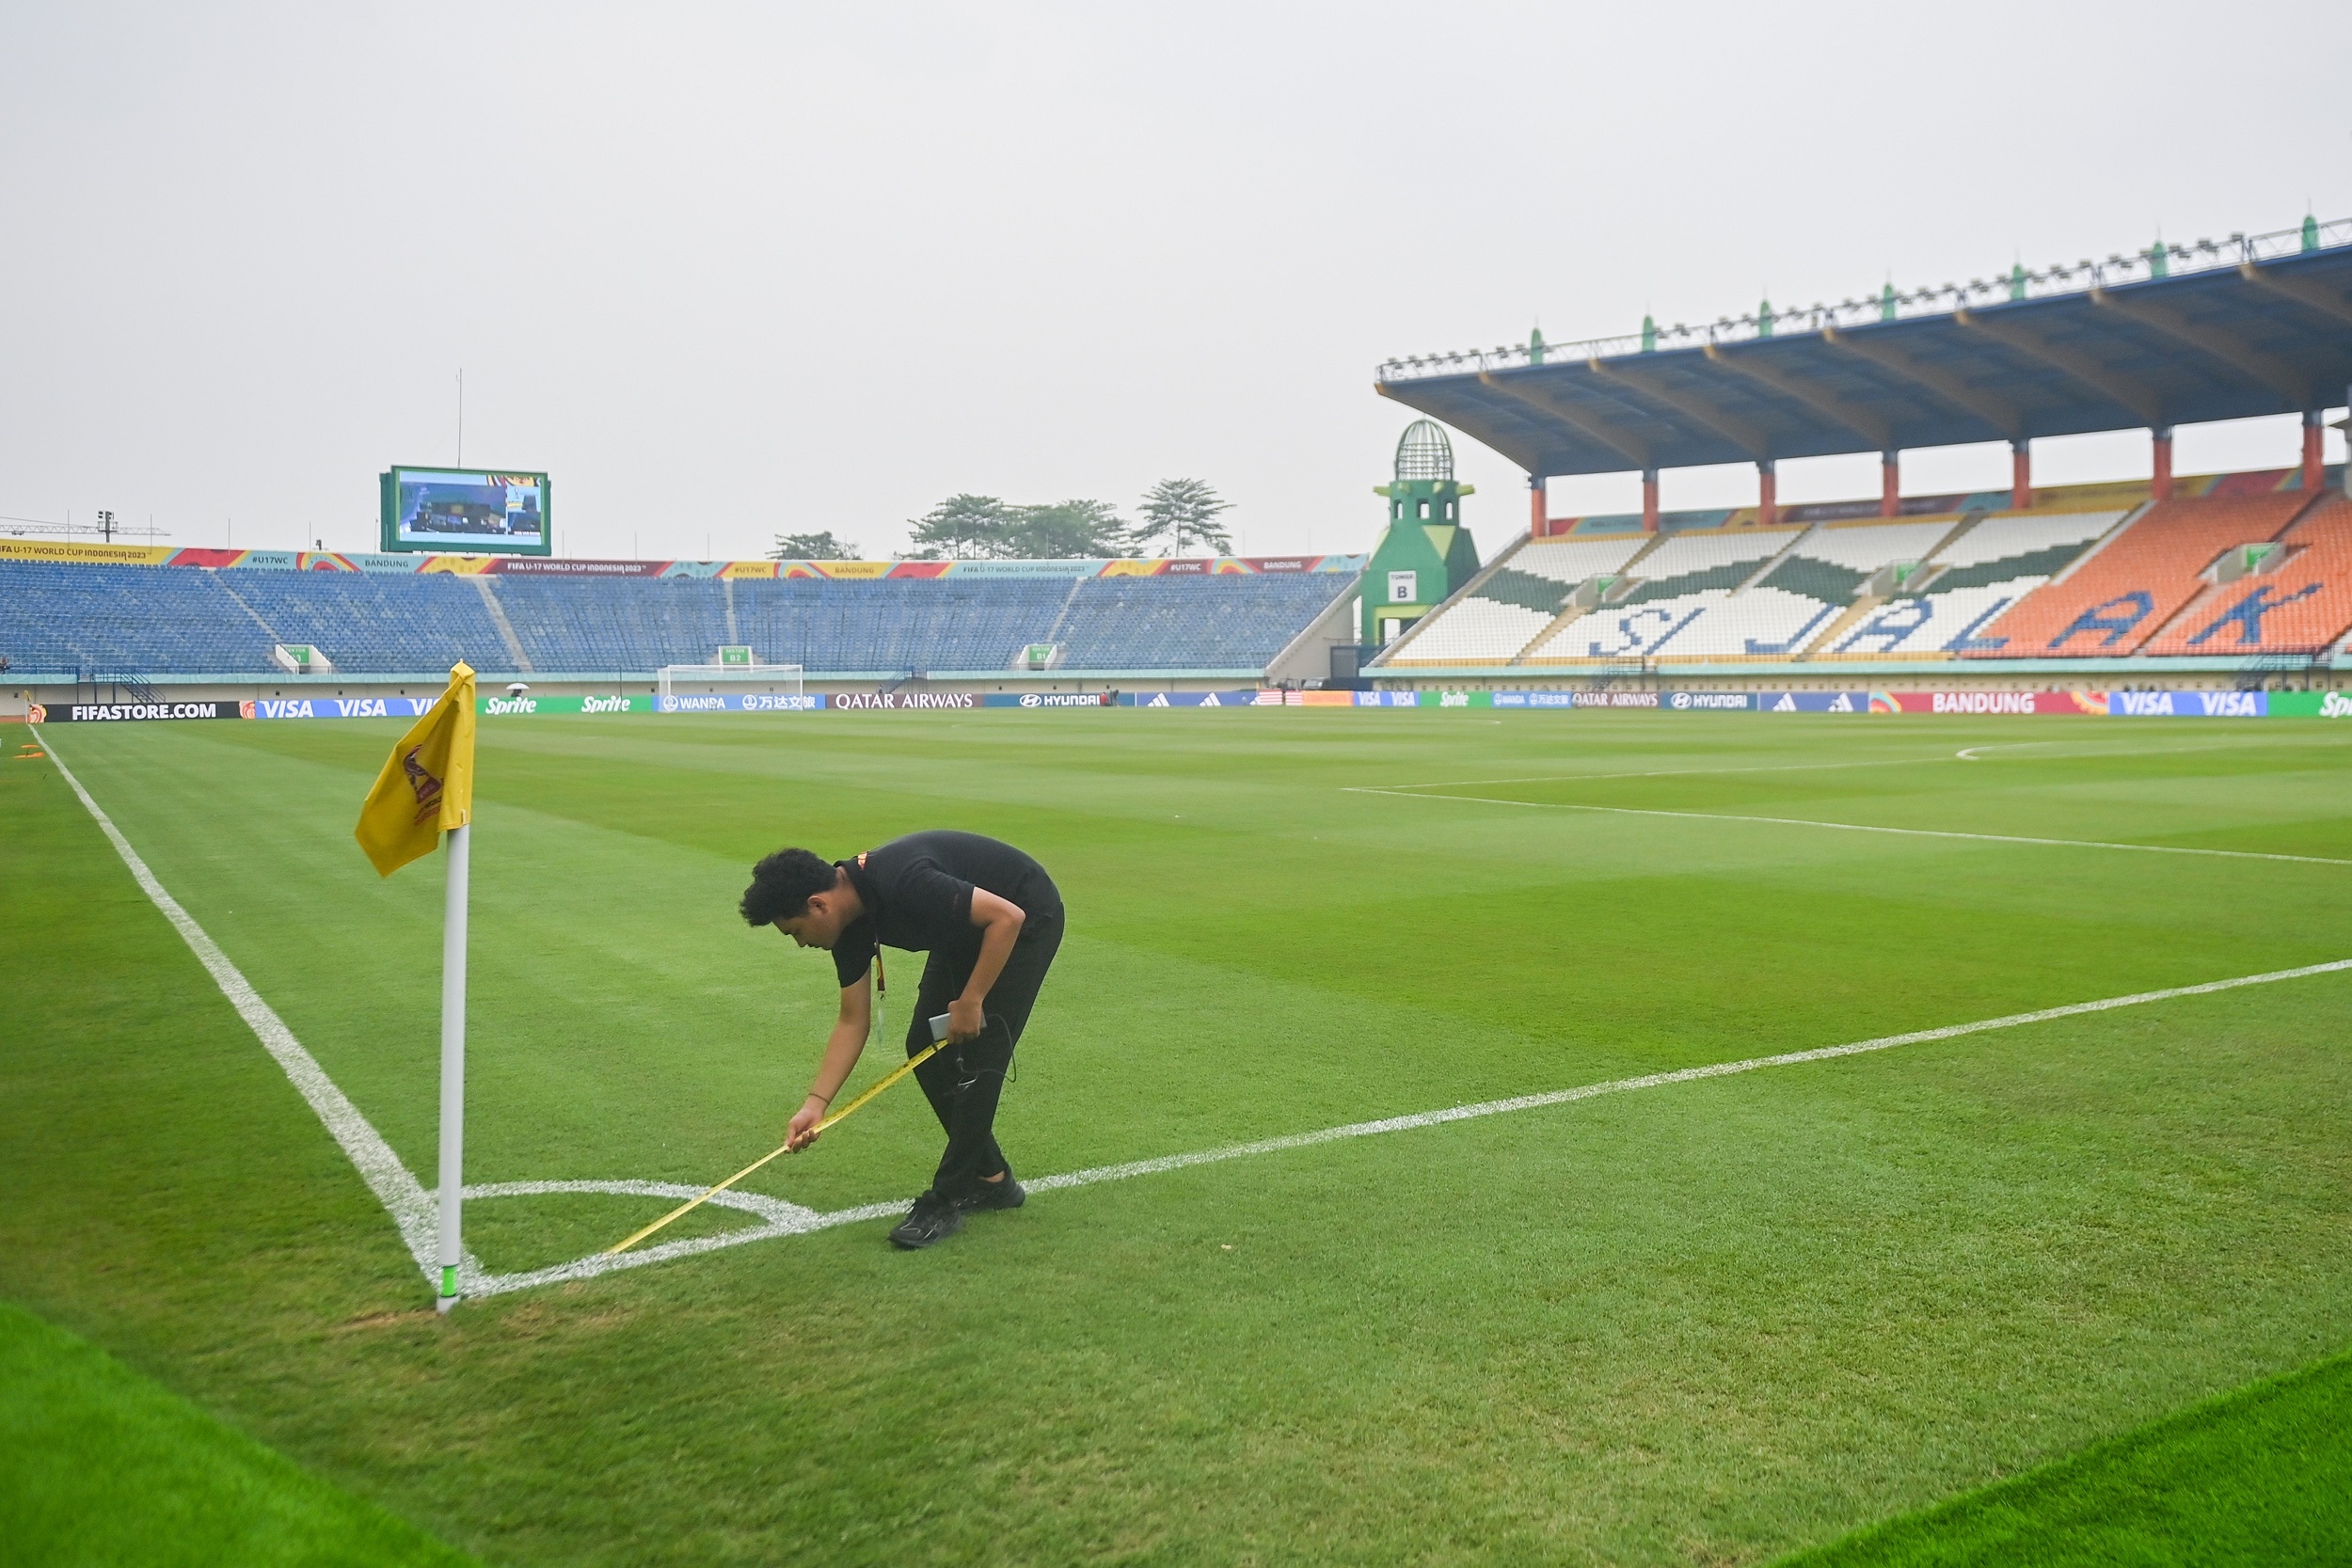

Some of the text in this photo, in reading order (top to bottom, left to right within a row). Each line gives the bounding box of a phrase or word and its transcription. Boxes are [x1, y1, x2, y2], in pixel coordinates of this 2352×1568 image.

[33, 547, 65, 556] WORLD
[67, 548, 84, 557] CUP
[364, 560, 408, 568] BANDUNG
[507, 562, 525, 570] FIFA
[526, 562, 542, 571] U-17
[543, 563, 570, 572] WORLD
[572, 563, 586, 572] CUP
[1397, 586, 1406, 598] B
[485, 695, 630, 715] Sprite Sprite
[759, 695, 816, 709] 万达文旅
[835, 693, 973, 709] QATAR AIRWAYS
[1044, 695, 1100, 705] HYUNDAI
[1358, 691, 1381, 706] VISA
[1391, 691, 1415, 706] VISA
[1439, 690, 1469, 707] Sprite
[1572, 693, 1658, 706] QATAR AIRWAYS
[1693, 694, 1747, 708] HYUNDAI
[1932, 692, 2035, 714] BANDUNG
[2119, 691, 2257, 716] VISA VISA
[72, 704, 216, 721] FIFASTORE.COM
[259, 700, 314, 719] VISA
[334, 699, 388, 718] VISA
